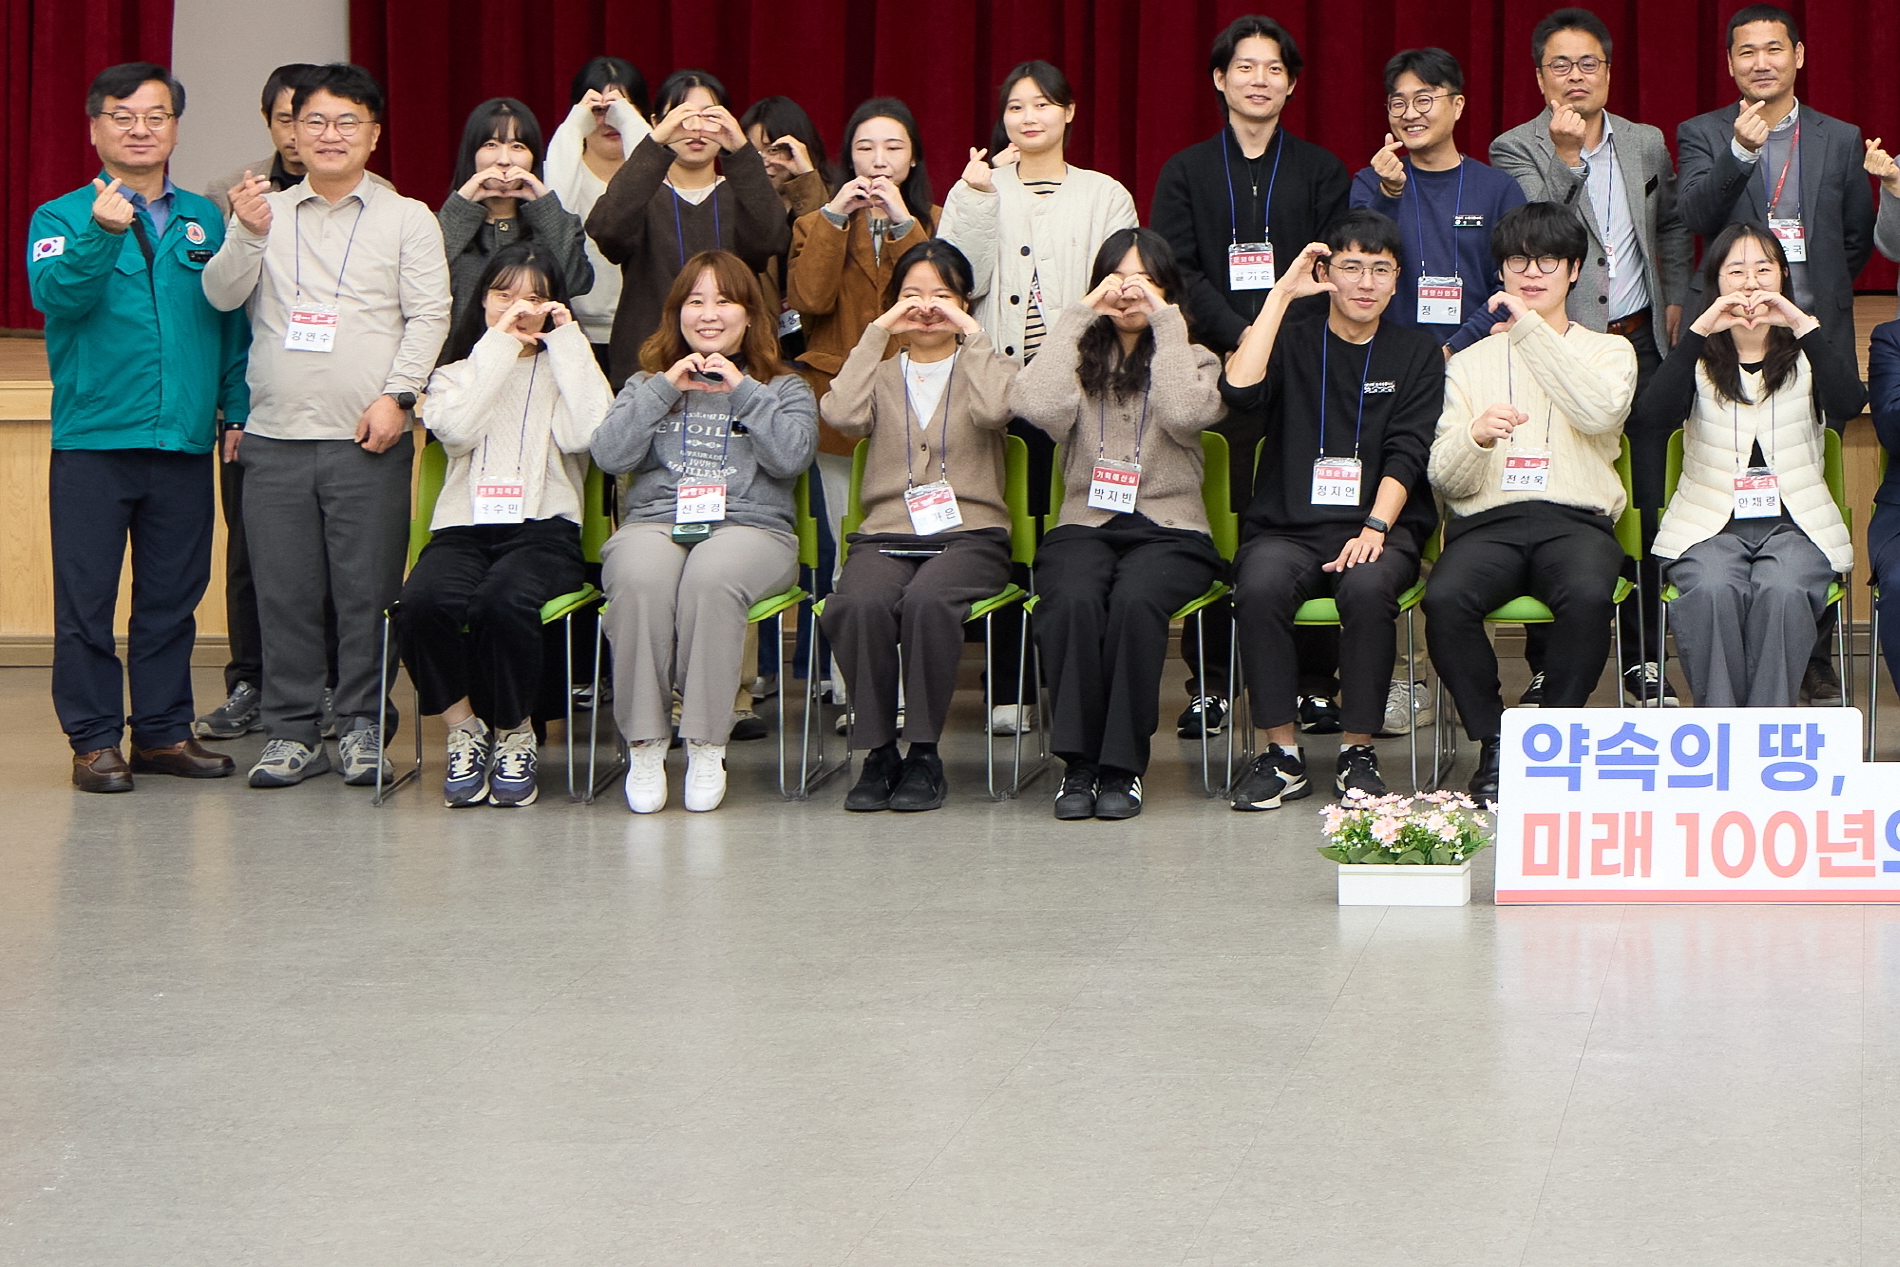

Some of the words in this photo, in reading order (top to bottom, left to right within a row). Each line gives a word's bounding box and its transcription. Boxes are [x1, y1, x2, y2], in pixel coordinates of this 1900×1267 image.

[1094, 486, 1132, 505] 박지빈
[1522, 721, 1731, 792] 약속의
[1759, 722, 1846, 796] 땅,
[1522, 809, 1653, 879] 미래
